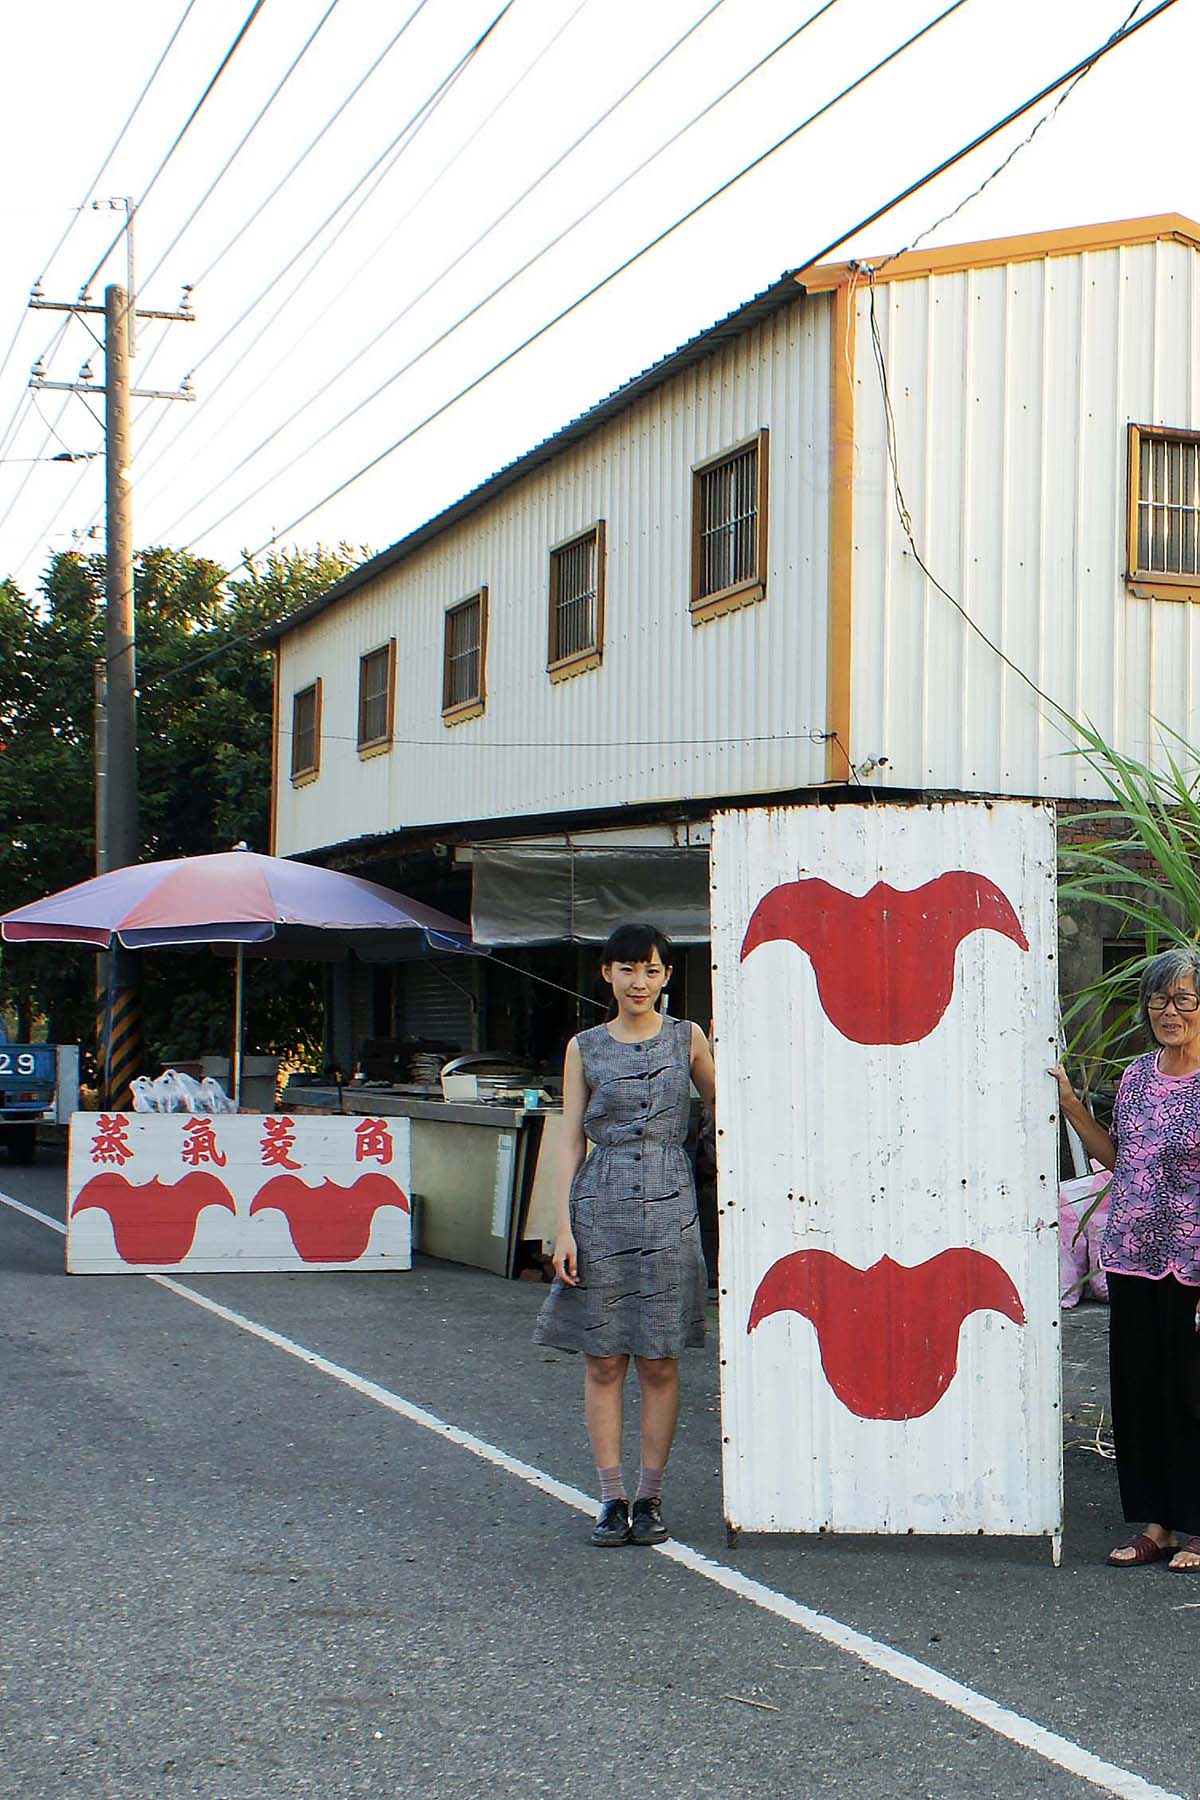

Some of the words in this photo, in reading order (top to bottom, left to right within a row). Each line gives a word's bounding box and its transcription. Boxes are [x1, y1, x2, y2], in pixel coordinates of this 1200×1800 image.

[0, 1053, 36, 1076] 29
[91, 1114, 393, 1169] 蒸氣菱角
